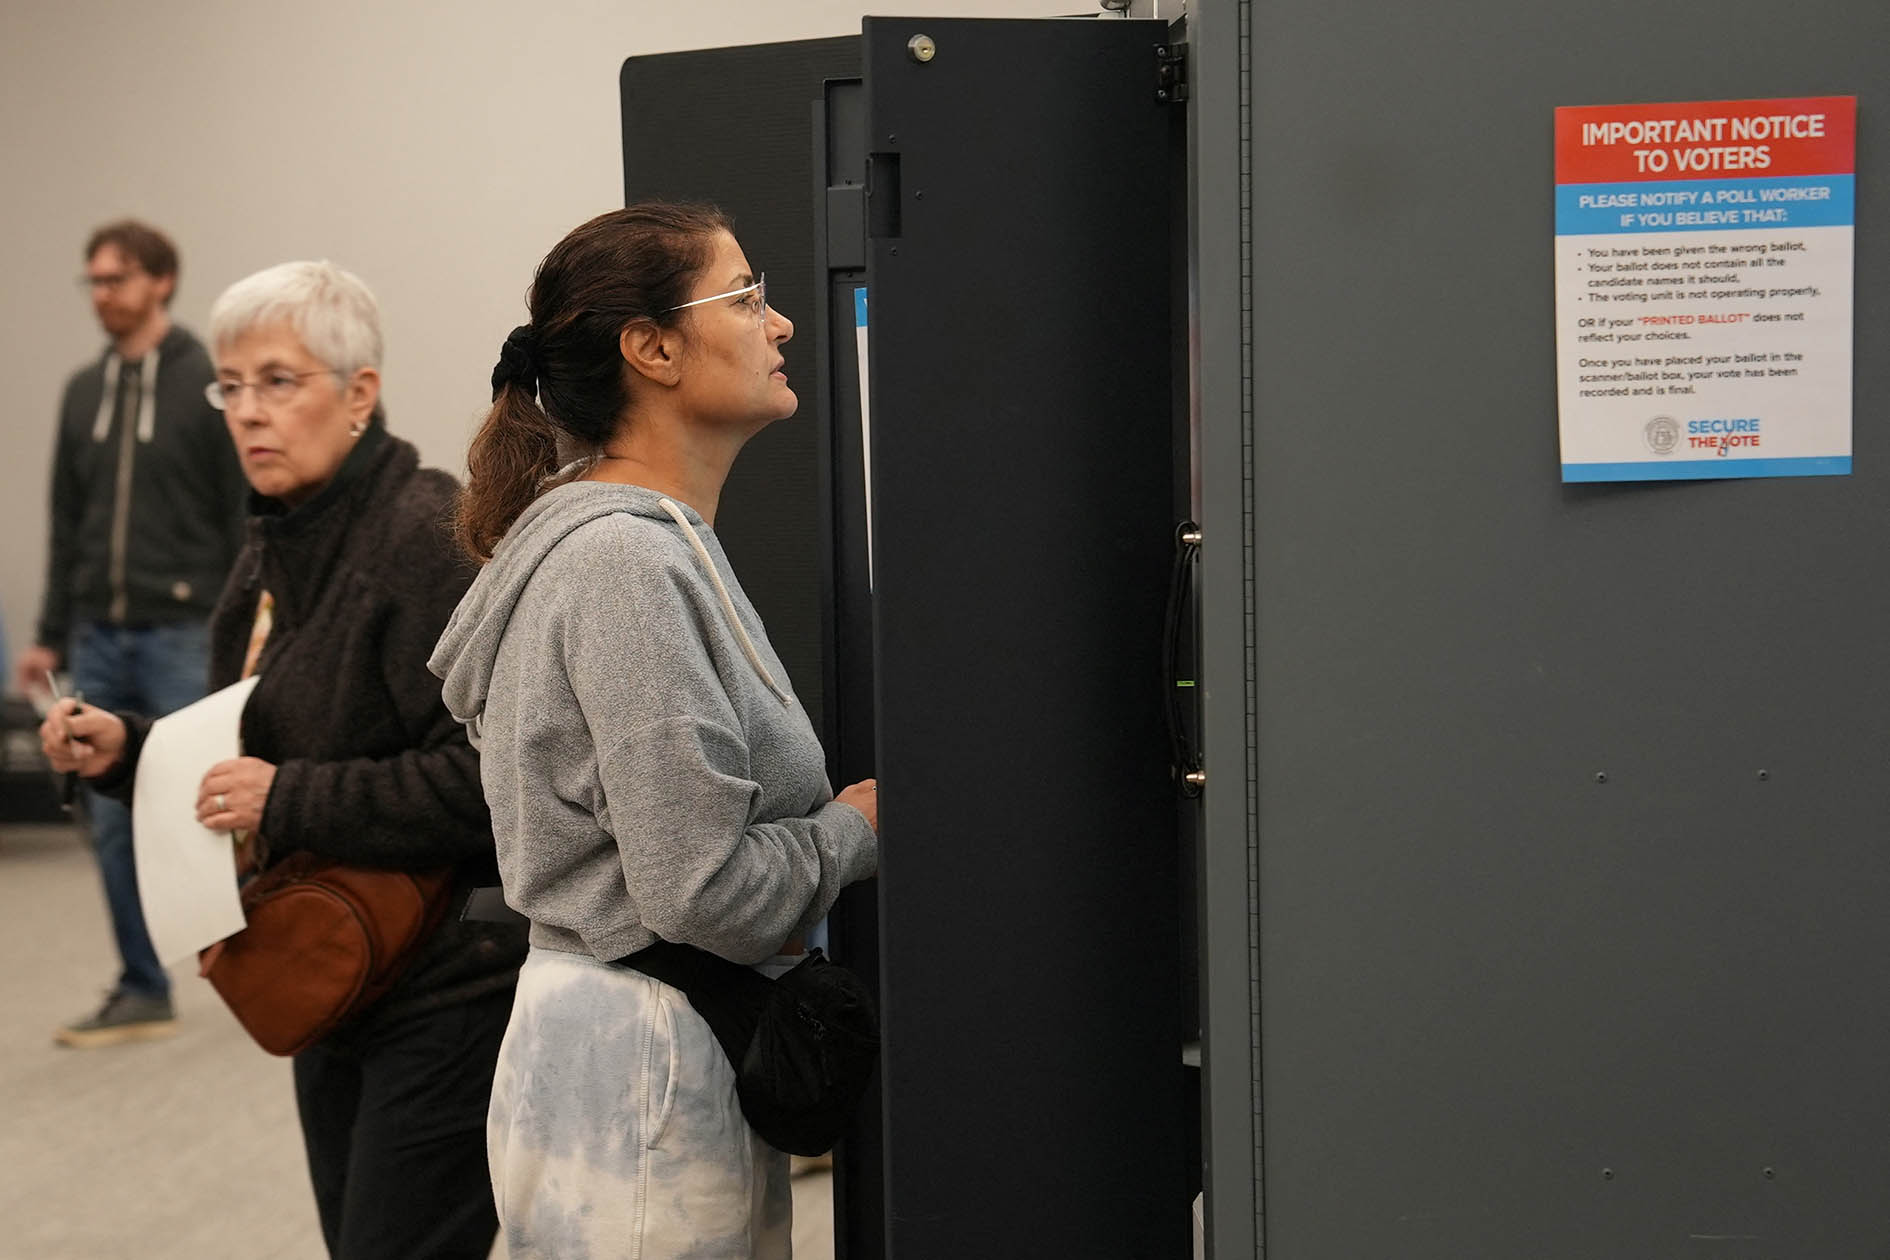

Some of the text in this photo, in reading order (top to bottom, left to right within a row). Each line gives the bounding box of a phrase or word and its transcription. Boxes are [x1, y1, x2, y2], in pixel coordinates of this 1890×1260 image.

[1582, 114, 1826, 146] IMPORTANT NOTICE
[1633, 146, 1771, 173] TO VOTERS
[1579, 186, 1830, 209] PLEASE NOTIFY A POLL WORKER
[1620, 208, 1788, 227] IF YOU BELIEVE THAT:
[1588, 248, 1609, 257] You
[1612, 248, 1639, 256] have
[1642, 246, 1671, 256] been
[1673, 245, 1705, 257] given
[1708, 244, 1727, 254] the
[1730, 244, 1767, 255] wrong
[1588, 257, 1785, 272] Your ballot does not contain all the
[1588, 277, 1643, 288] candidate
[1646, 278, 1684, 286] names
[1687, 275, 1695, 284] it
[1588, 292, 1609, 302] The
[1612, 291, 1648, 303] voting
[1651, 290, 1673, 300] unit
[1676, 289, 1685, 299] is
[1688, 289, 1708, 299] not
[1710, 287, 1766, 300] operating
[1578, 318, 1596, 328] OR
[1598, 318, 1606, 327] if
[1608, 318, 1633, 329] your
[1753, 312, 1781, 322] does
[1784, 312, 1804, 321] not
[1578, 333, 1614, 343] reflect
[1616, 333, 1641, 344] your
[1579, 352, 1803, 369] Once you have placed your ballot in the
[1579, 371, 1658, 382] scanner/ballot
[1688, 370, 1713, 381] your
[1716, 369, 1741, 379] vote
[1744, 368, 1765, 377] has
[1768, 368, 1798, 377] been
[1579, 387, 1629, 398] recorded
[1631, 386, 1653, 396] and
[1656, 386, 1665, 395] is
[1688, 419, 1760, 434] SECURE
[1688, 436, 1718, 448] THE
